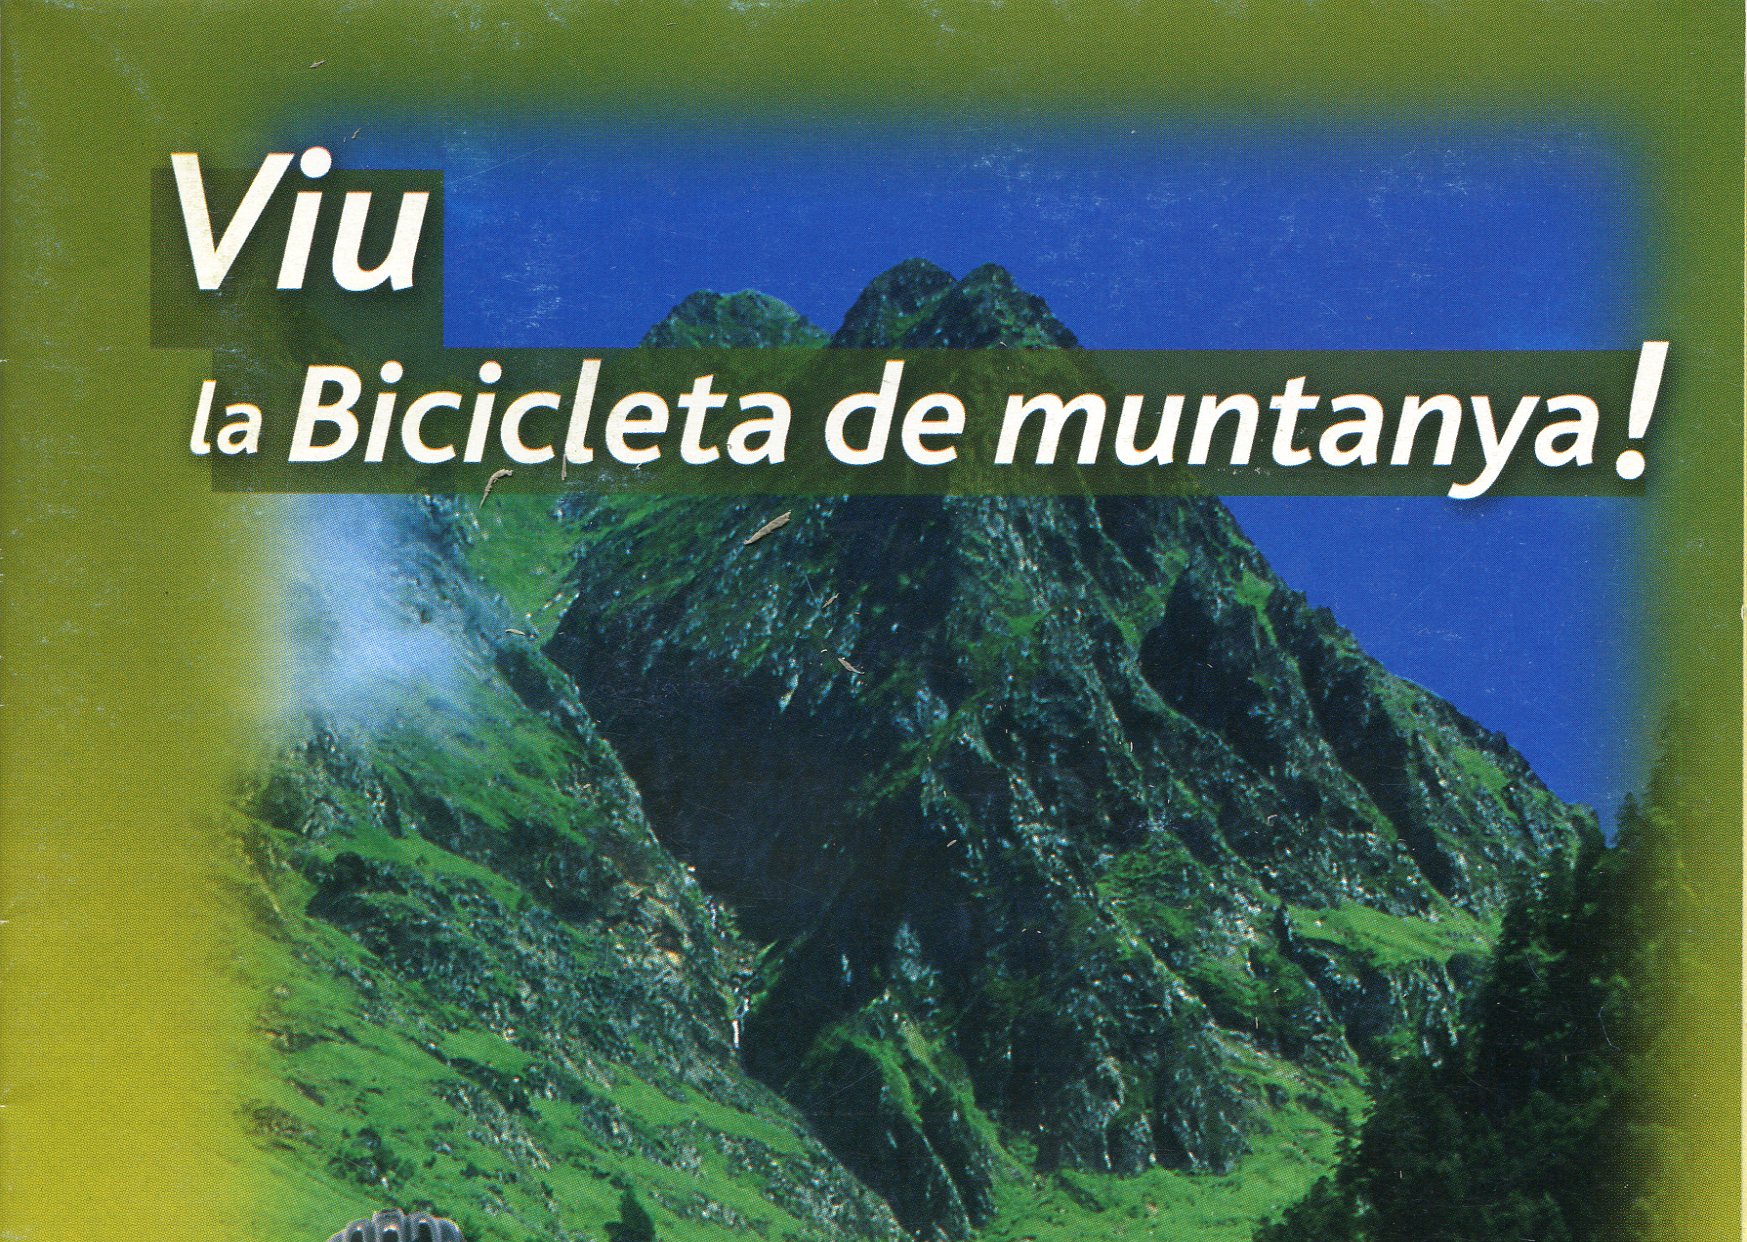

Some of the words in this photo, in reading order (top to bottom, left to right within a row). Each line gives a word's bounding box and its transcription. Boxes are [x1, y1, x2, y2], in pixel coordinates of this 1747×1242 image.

[171, 147, 430, 292] Viu
[190, 380, 262, 455] la
[287, 360, 791, 467] Bicicleta
[824, 360, 966, 465] de
[994, 341, 1670, 500] muntanya!
